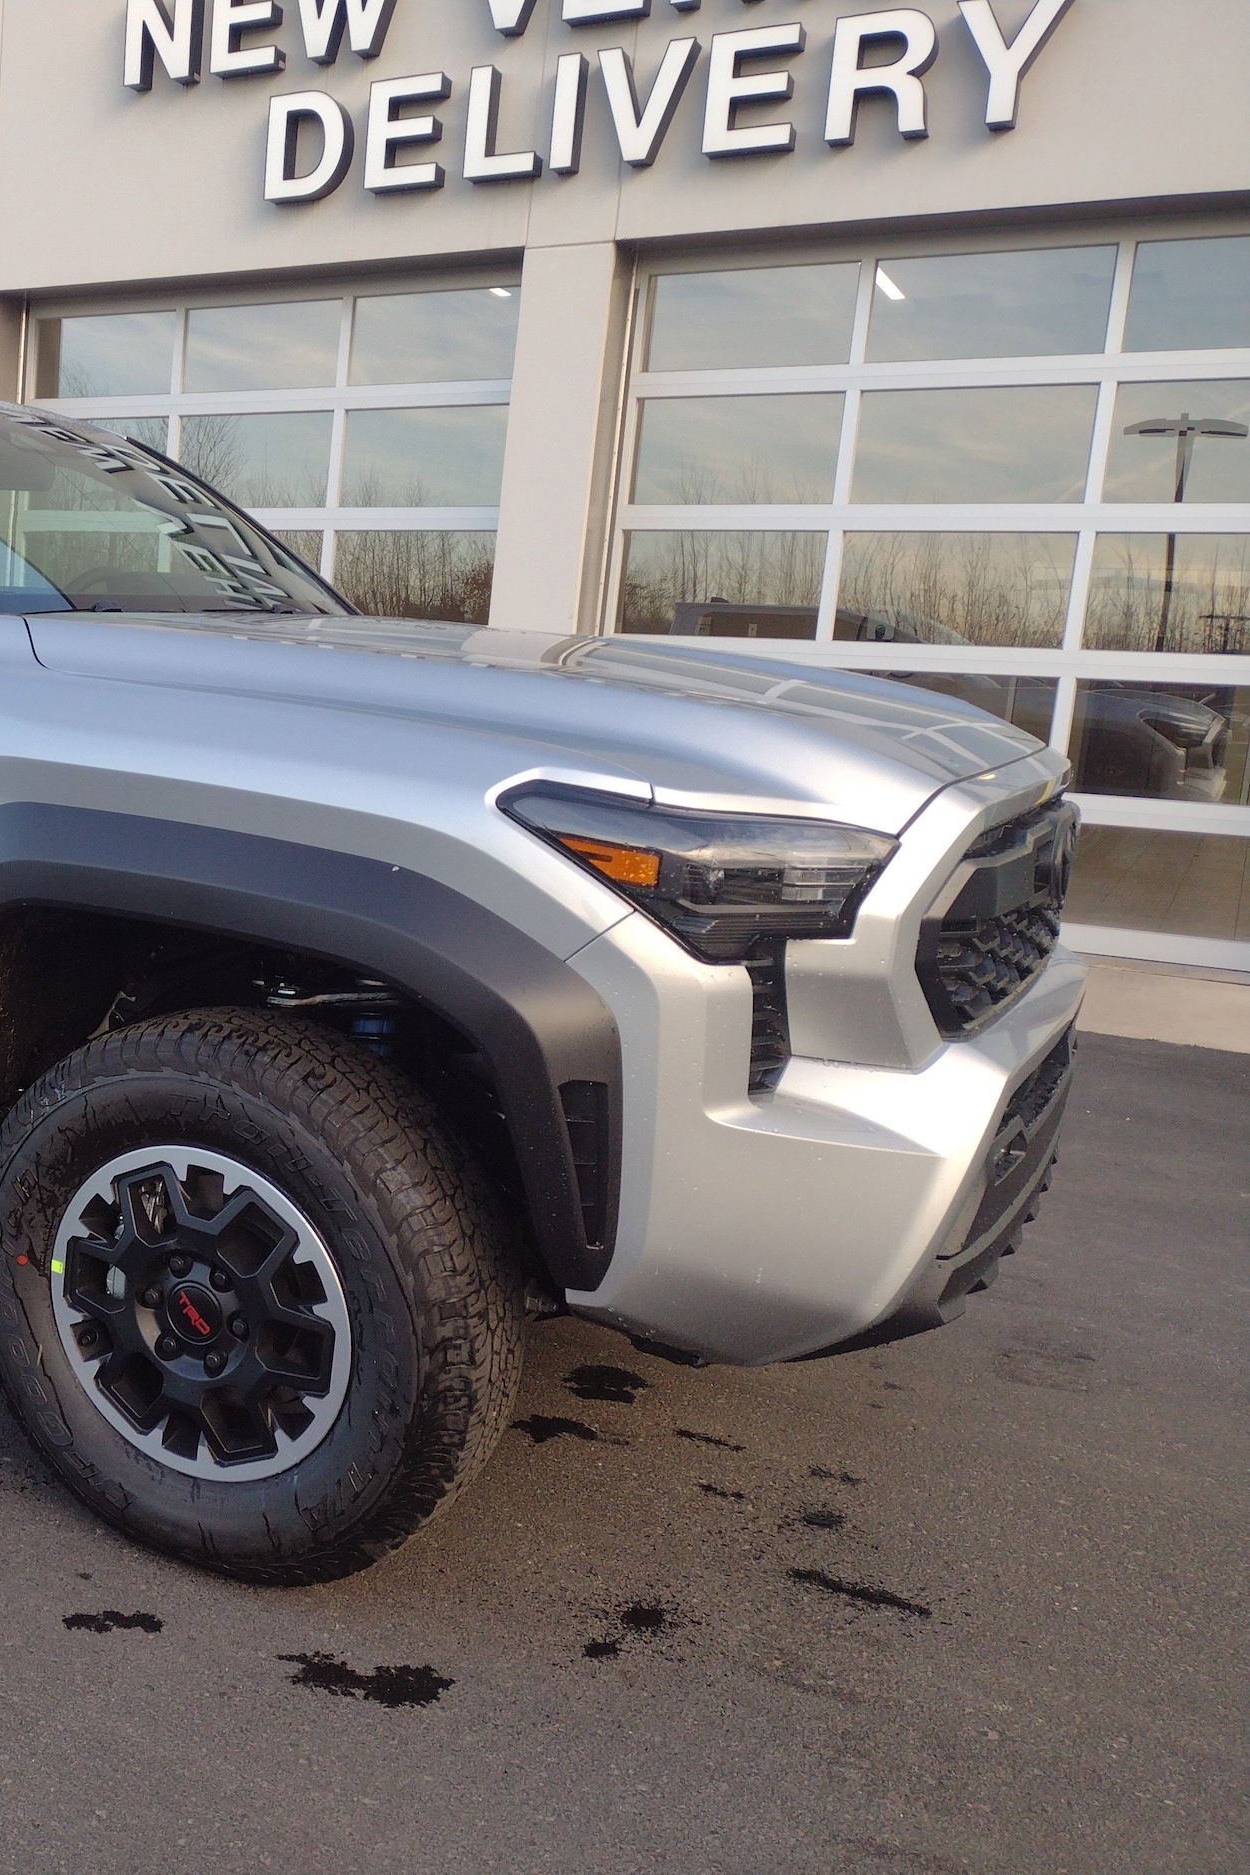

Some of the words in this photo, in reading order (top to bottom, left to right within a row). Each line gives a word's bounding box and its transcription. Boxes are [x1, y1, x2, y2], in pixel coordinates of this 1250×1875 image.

[123, 0, 396, 92] NEW
[263, 0, 1075, 205] DELIVERY
[178, 1290, 211, 1335] TRD
